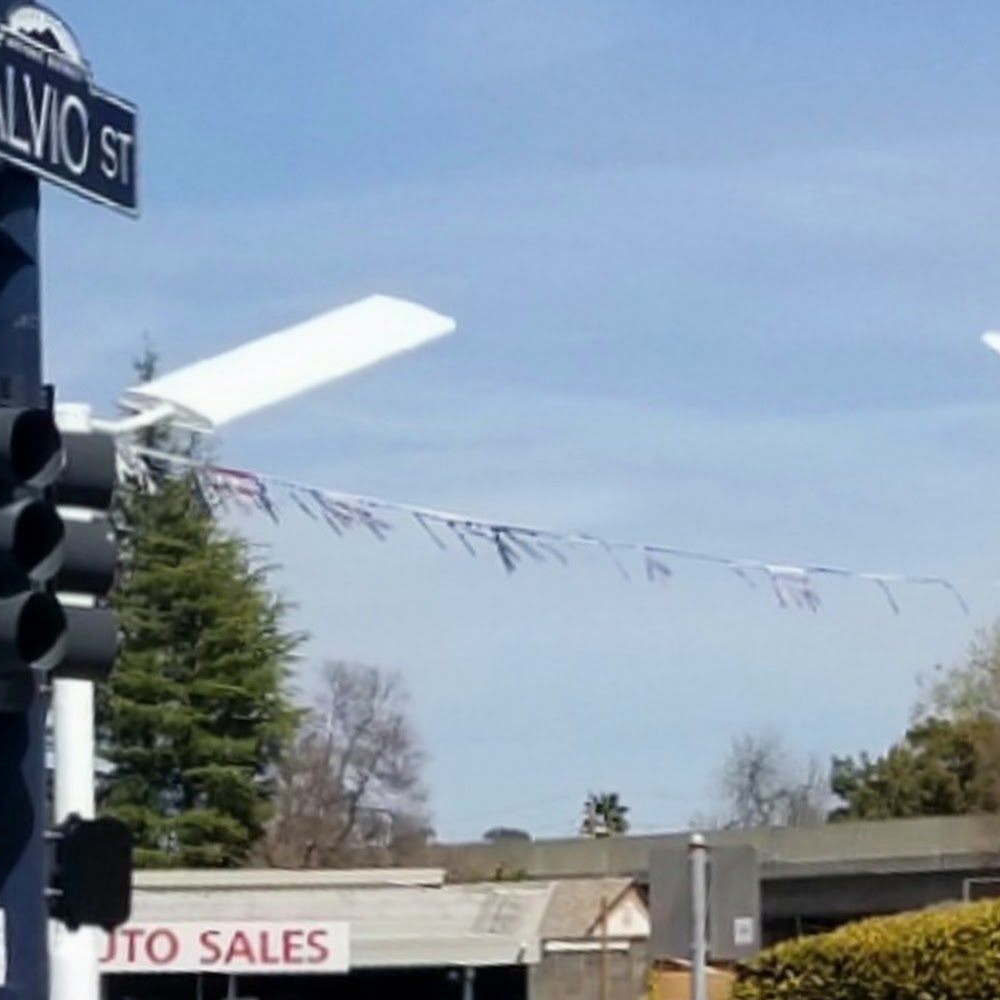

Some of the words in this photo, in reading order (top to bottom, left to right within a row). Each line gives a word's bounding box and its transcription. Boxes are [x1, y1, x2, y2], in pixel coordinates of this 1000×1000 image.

[100, 125, 134, 185] ST
[97, 928, 180, 965] UTO
[199, 928, 330, 965] SALES
